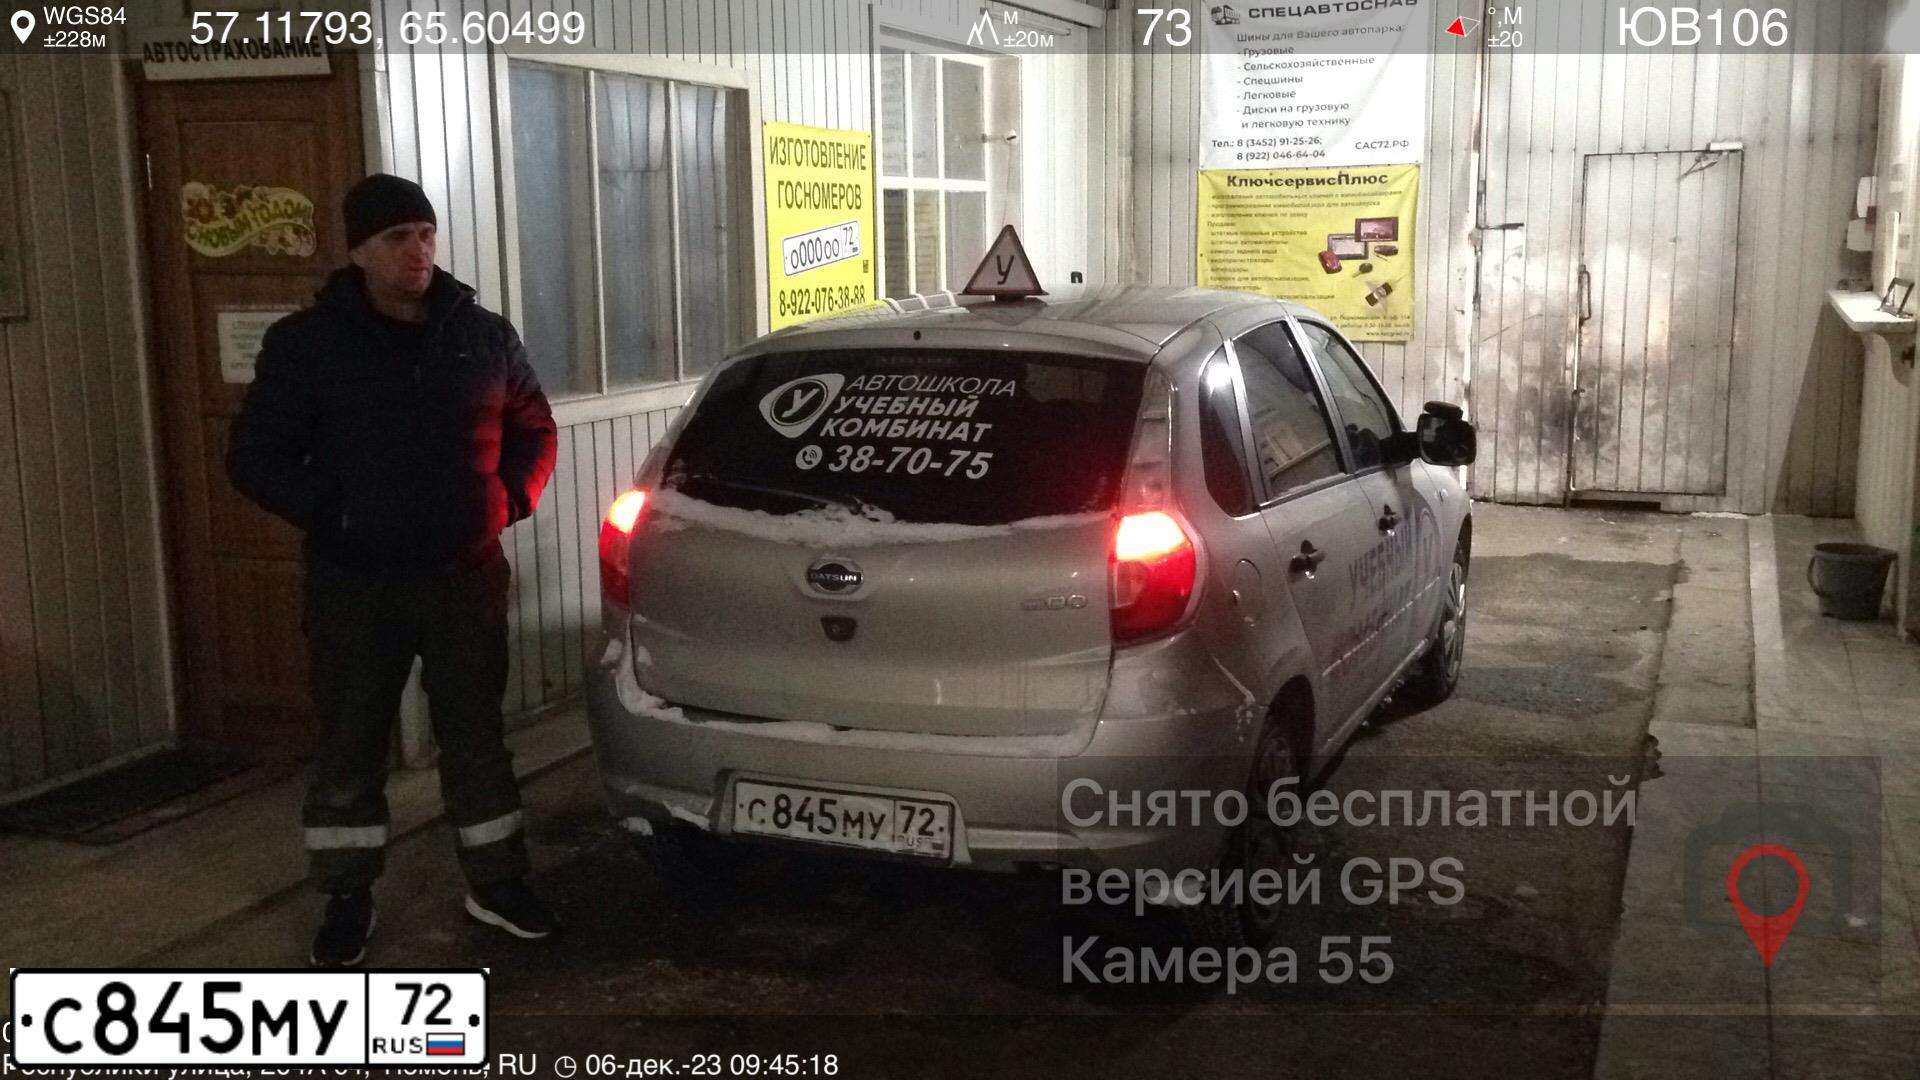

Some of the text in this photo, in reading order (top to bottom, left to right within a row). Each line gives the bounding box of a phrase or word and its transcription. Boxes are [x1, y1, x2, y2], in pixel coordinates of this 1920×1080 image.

[1237, 33, 1270, 42] Шины
[1272, 33, 1293, 41] для
[1297, 29, 1339, 40] Вашего
[143, 36, 322, 63] АВТОСТРАХОВАНИЕ
[1243, 46, 1294, 57] Грузовые
[1244, 56, 1375, 71] Сельскохозяйственные
[1243, 75, 1303, 86] Спецшины
[1243, 90, 1296, 100] Легковые
[1243, 105, 1277, 116] Диски
[1296, 102, 1350, 114] грузовую
[1251, 119, 1304, 131] легковую
[1307, 117, 1351, 129] технику
[1236, 138, 1243, 147] 8
[1246, 137, 1276, 148] (3452)
[769, 136, 867, 171] ИЗГОТОВЛЕНИЕ
[1236, 152, 1243, 161] 8
[1246, 151, 1270, 161] (922)
[777, 180, 862, 210] ГОСНОМЕРОВ
[842, 226, 854, 246] 72
[996, 254, 1014, 285] У
[779, 284, 865, 317] 8-922-076-38-88
[846, 375, 1017, 397] АВТОШКОЛА
[834, 395, 980, 418] УЧЕБНЫЙ
[819, 417, 993, 443] КОМБИНАТ
[828, 445, 994, 480] 38-70-75
[810, 573, 858, 582] DATSUN
[900, 805, 935, 837] 72
